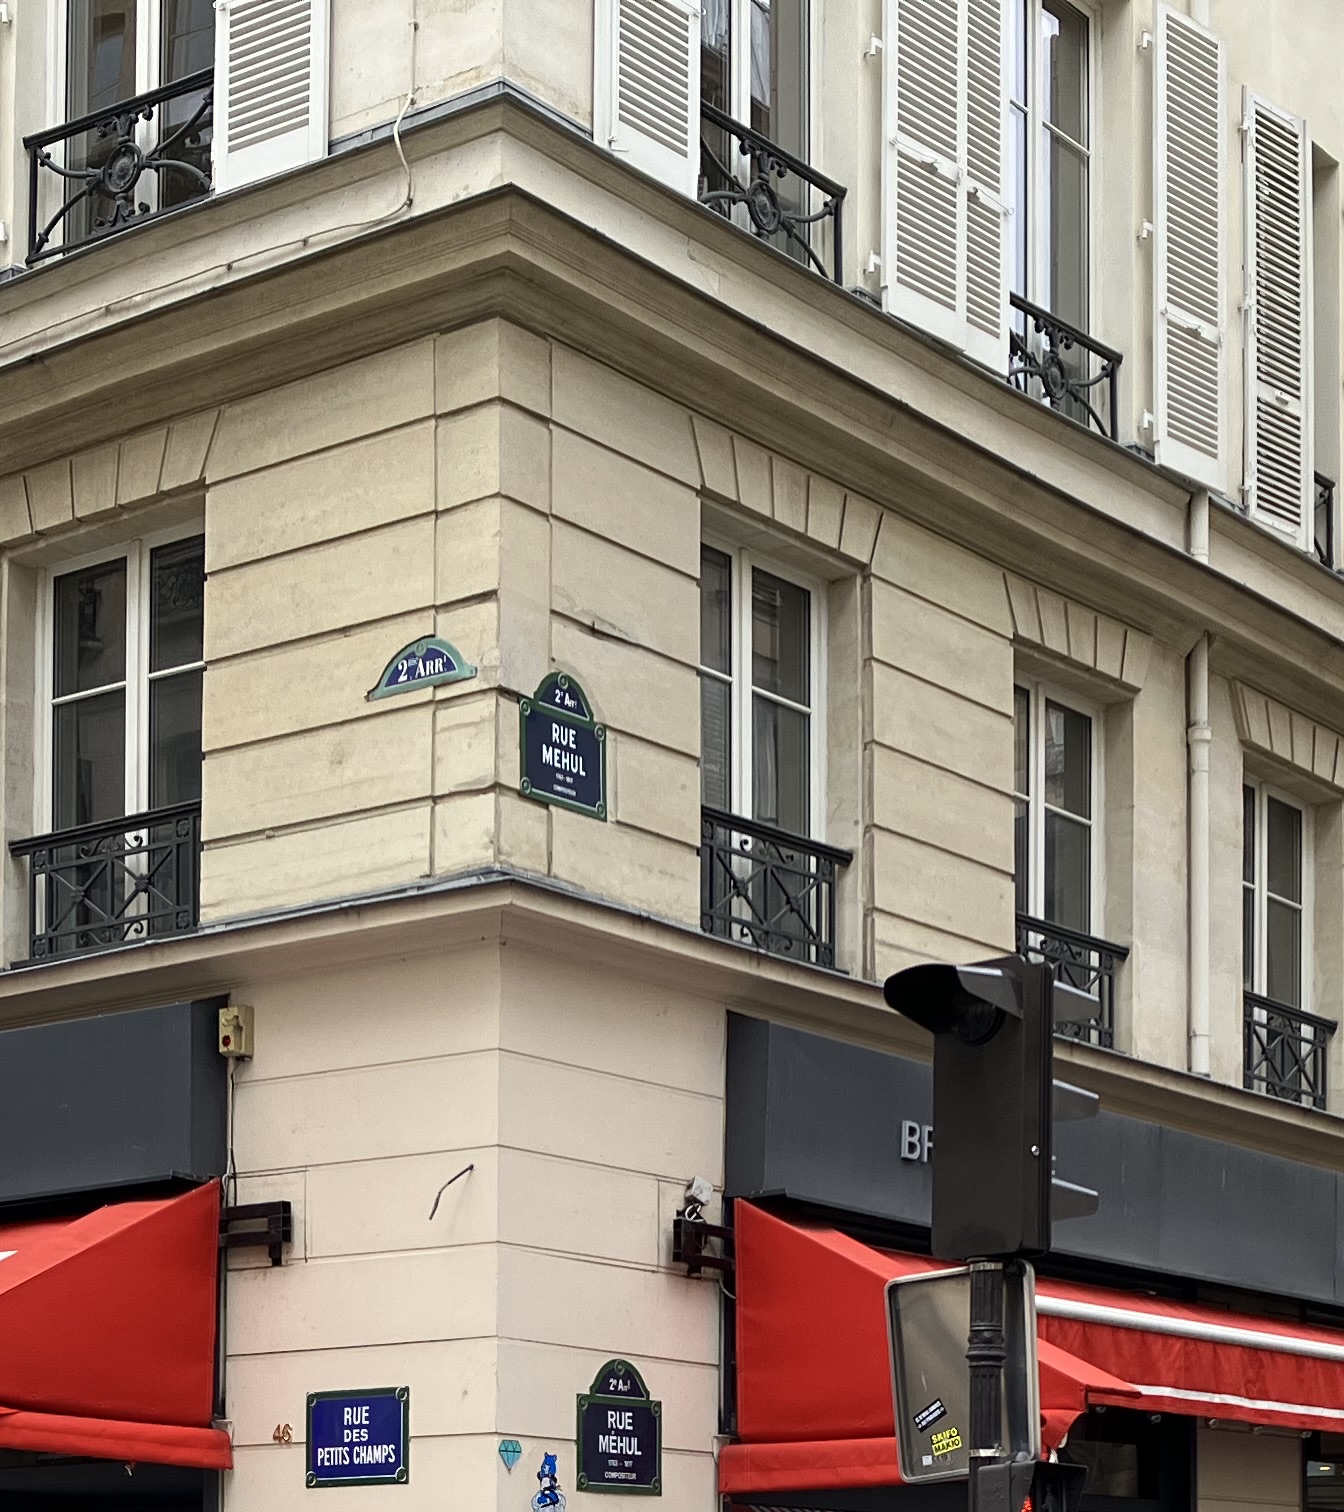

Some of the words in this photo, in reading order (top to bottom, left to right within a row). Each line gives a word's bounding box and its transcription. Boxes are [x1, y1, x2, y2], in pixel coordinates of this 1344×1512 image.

[552, 723, 577, 749] RUE
[542, 744, 586, 776] MEHUL
[343, 1406, 370, 1425] RUE
[607, 1411, 634, 1431] RUE
[273, 1423, 293, 1442] 46
[343, 1429, 369, 1443] DES
[598, 1431, 642, 1456] MÉHUL
[317, 1447, 350, 1467] PETITS
[353, 1444, 396, 1465] CHAMPS
